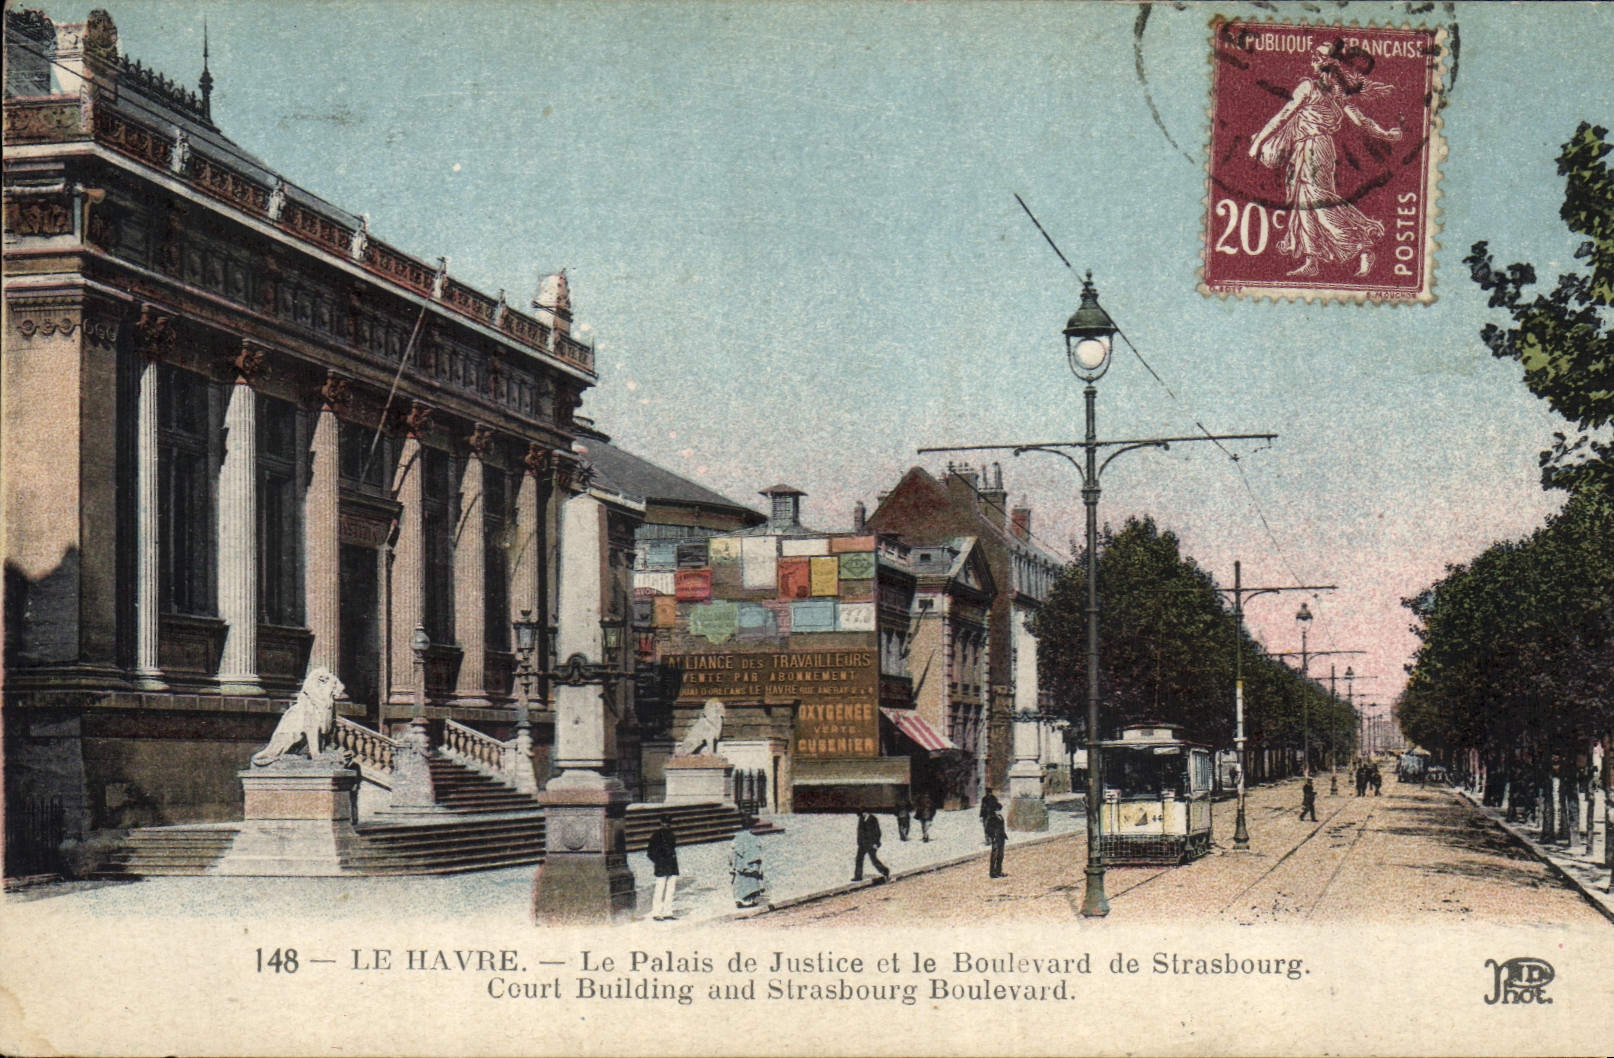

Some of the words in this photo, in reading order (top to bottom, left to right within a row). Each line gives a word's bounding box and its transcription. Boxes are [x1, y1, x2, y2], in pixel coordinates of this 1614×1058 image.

[1394, 192, 1417, 276] POSTES
[742, 659, 763, 669] DES
[772, 653, 872, 668] TRAVAILLEURS
[734, 672, 758, 682] PAR
[770, 671, 856, 681] ABONNEMENT
[749, 686, 761, 695] LE
[765, 685, 797, 695] HAVRE
[798, 739, 874, 753] CUSENIER
